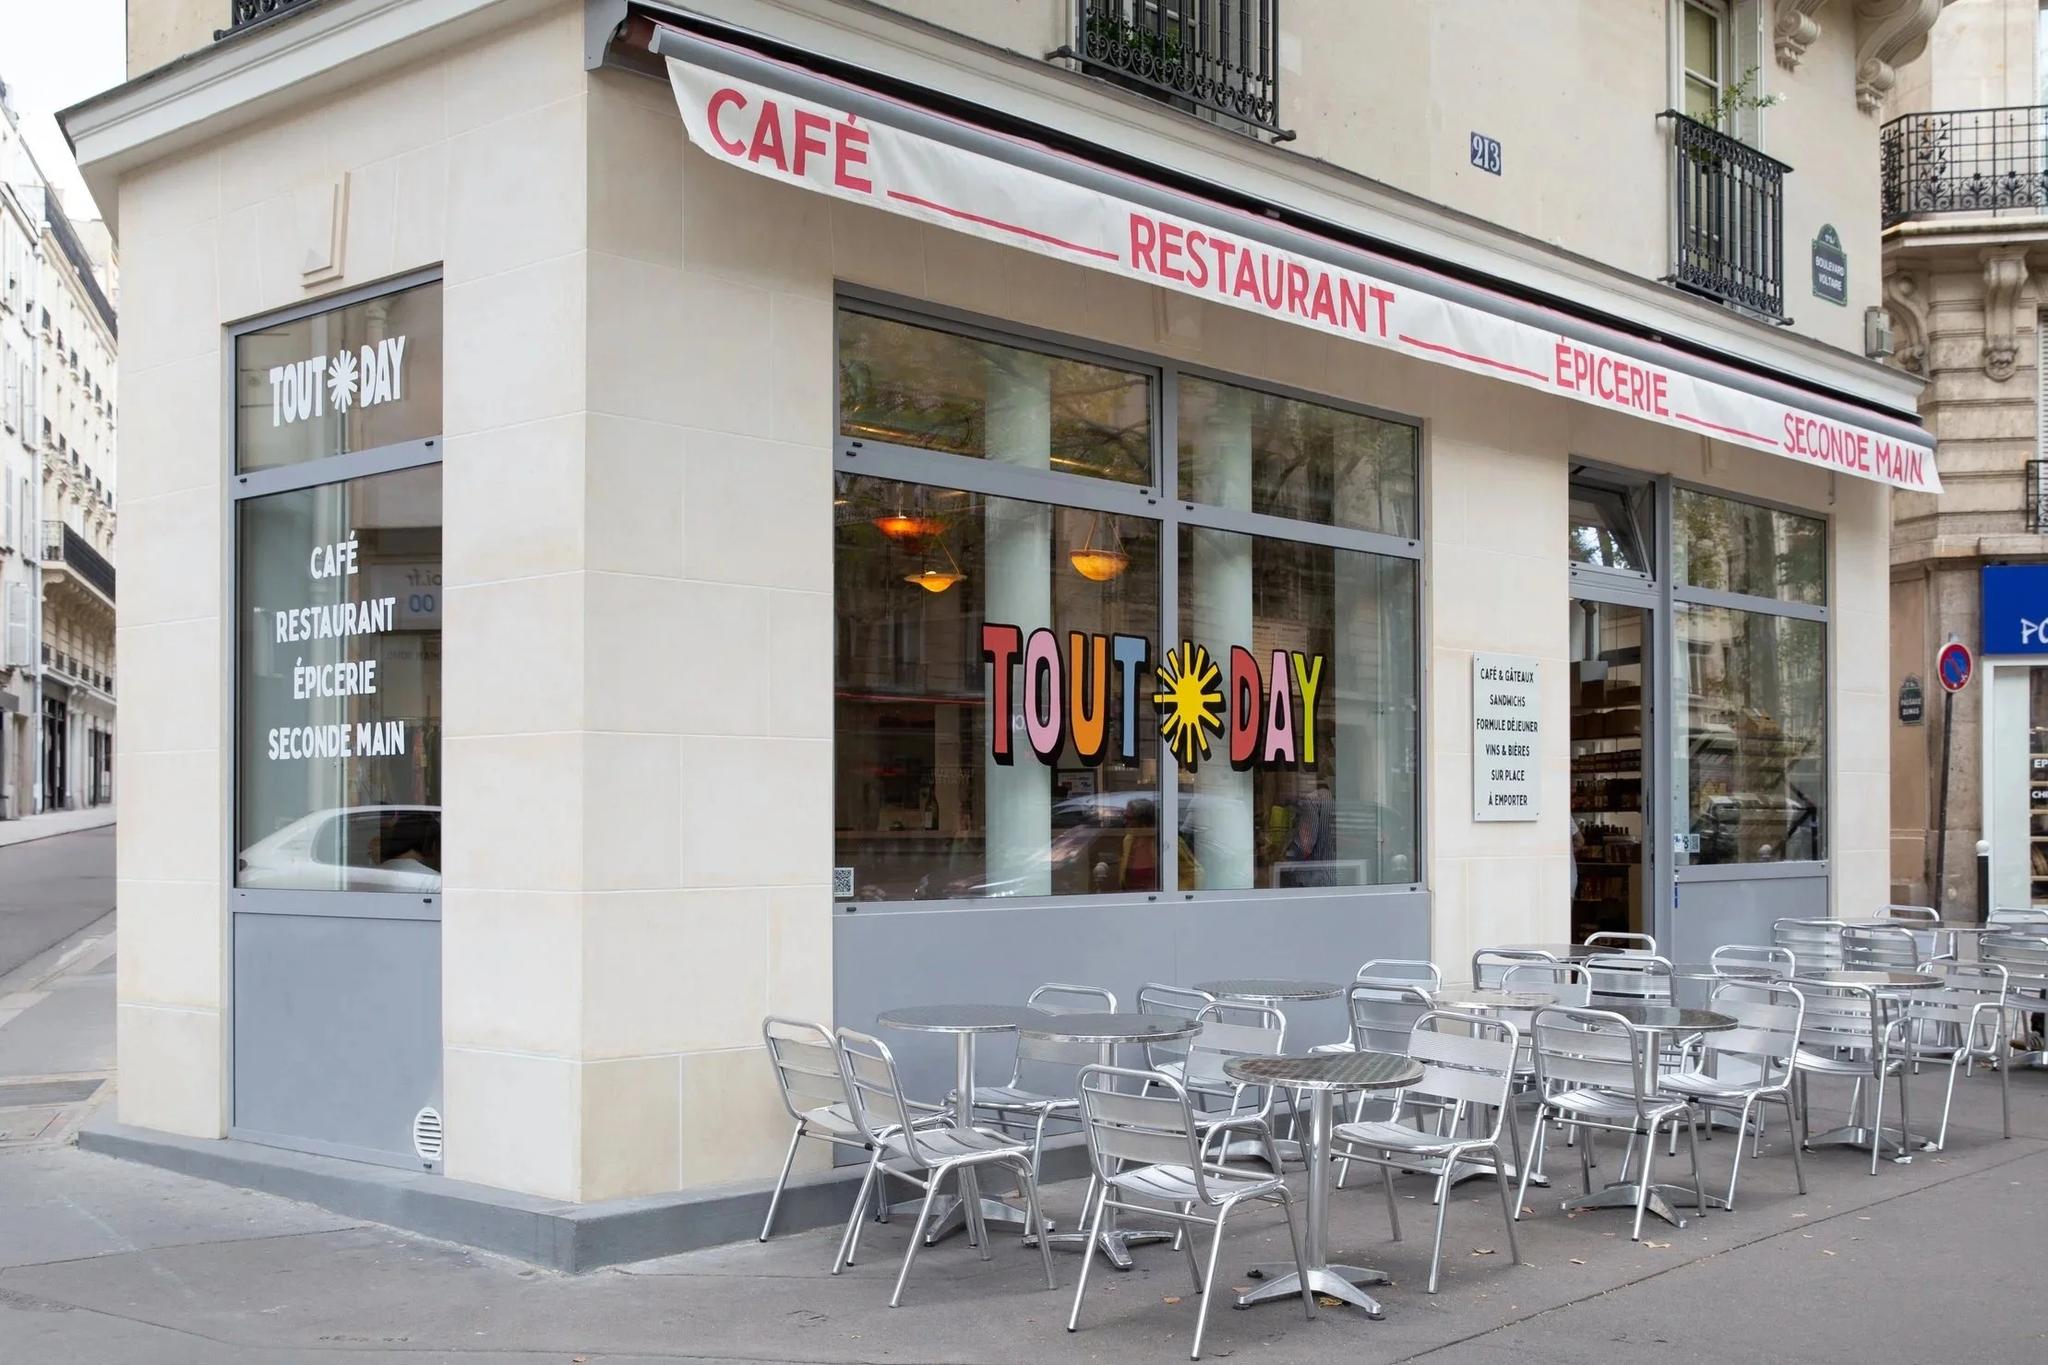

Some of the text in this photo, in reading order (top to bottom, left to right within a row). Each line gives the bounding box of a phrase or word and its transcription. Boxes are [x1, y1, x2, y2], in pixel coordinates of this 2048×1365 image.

[707, 88, 872, 194] CAFÉ
[1473, 136, 1500, 172] 213
[1130, 213, 1395, 337] RESTAURANT
[269, 335, 406, 427] TOUT DAY
[1556, 335, 1669, 417] ÉPICERIE
[1784, 413, 1924, 485] SECONDE MAIN
[310, 530, 359, 579] CAFÉ
[276, 597, 396, 643] RESTAURANT
[294, 656, 376, 700] ÉPICERIE
[1480, 665, 1534, 683] CAFÉ & GÂTEAUX
[982, 622, 1327, 772] TOUT DAY
[1489, 694, 1526, 707] SANDWICHS
[268, 720, 405, 760] SECONDE MAIN
[1476, 716, 1538, 732] FORMULE DÉJEUNER
[1486, 741, 1530, 757] VINS & BIÈRES
[1491, 769, 1525, 781] SUR PLACE
[1488, 791, 1528, 806] À EMPORTER
